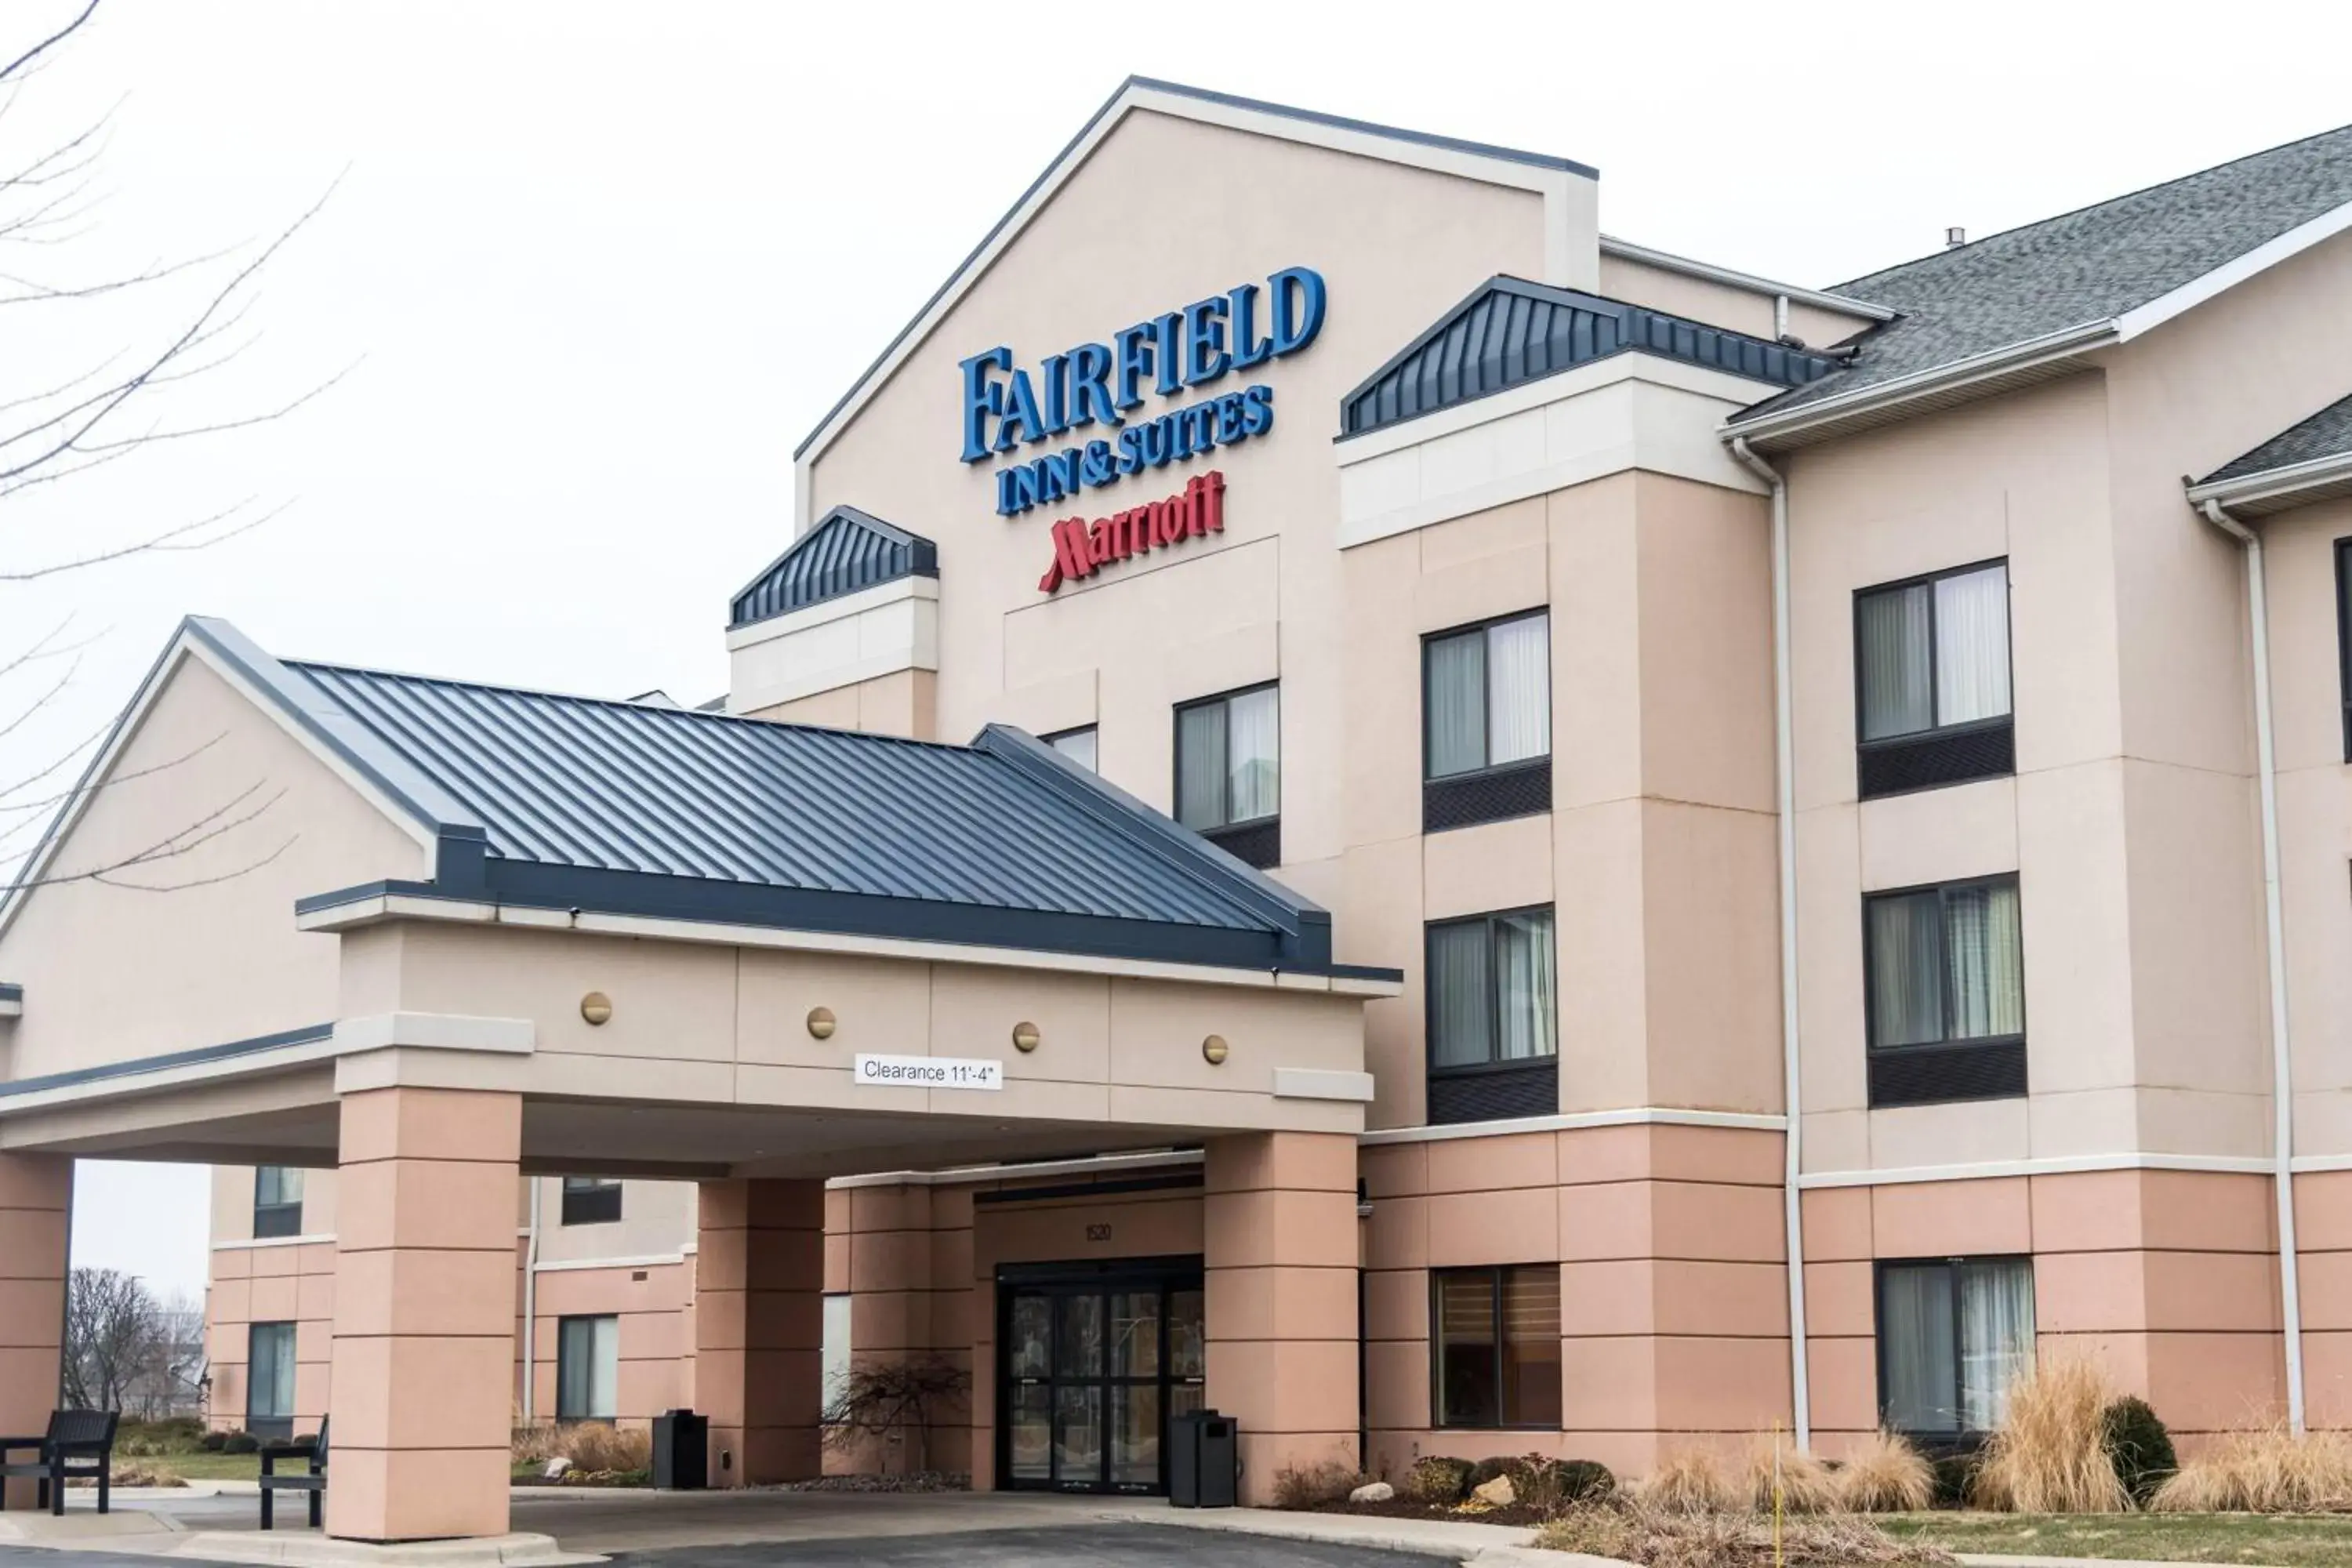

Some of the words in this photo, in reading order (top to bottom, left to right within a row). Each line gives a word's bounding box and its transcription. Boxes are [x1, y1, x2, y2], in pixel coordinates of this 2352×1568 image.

[960, 266, 1327, 465] FAIRFIELD
[1038, 470, 1227, 593] Marriott
[864, 1060, 946, 1081] Clearance
[1086, 1223, 1112, 1242] 1520
